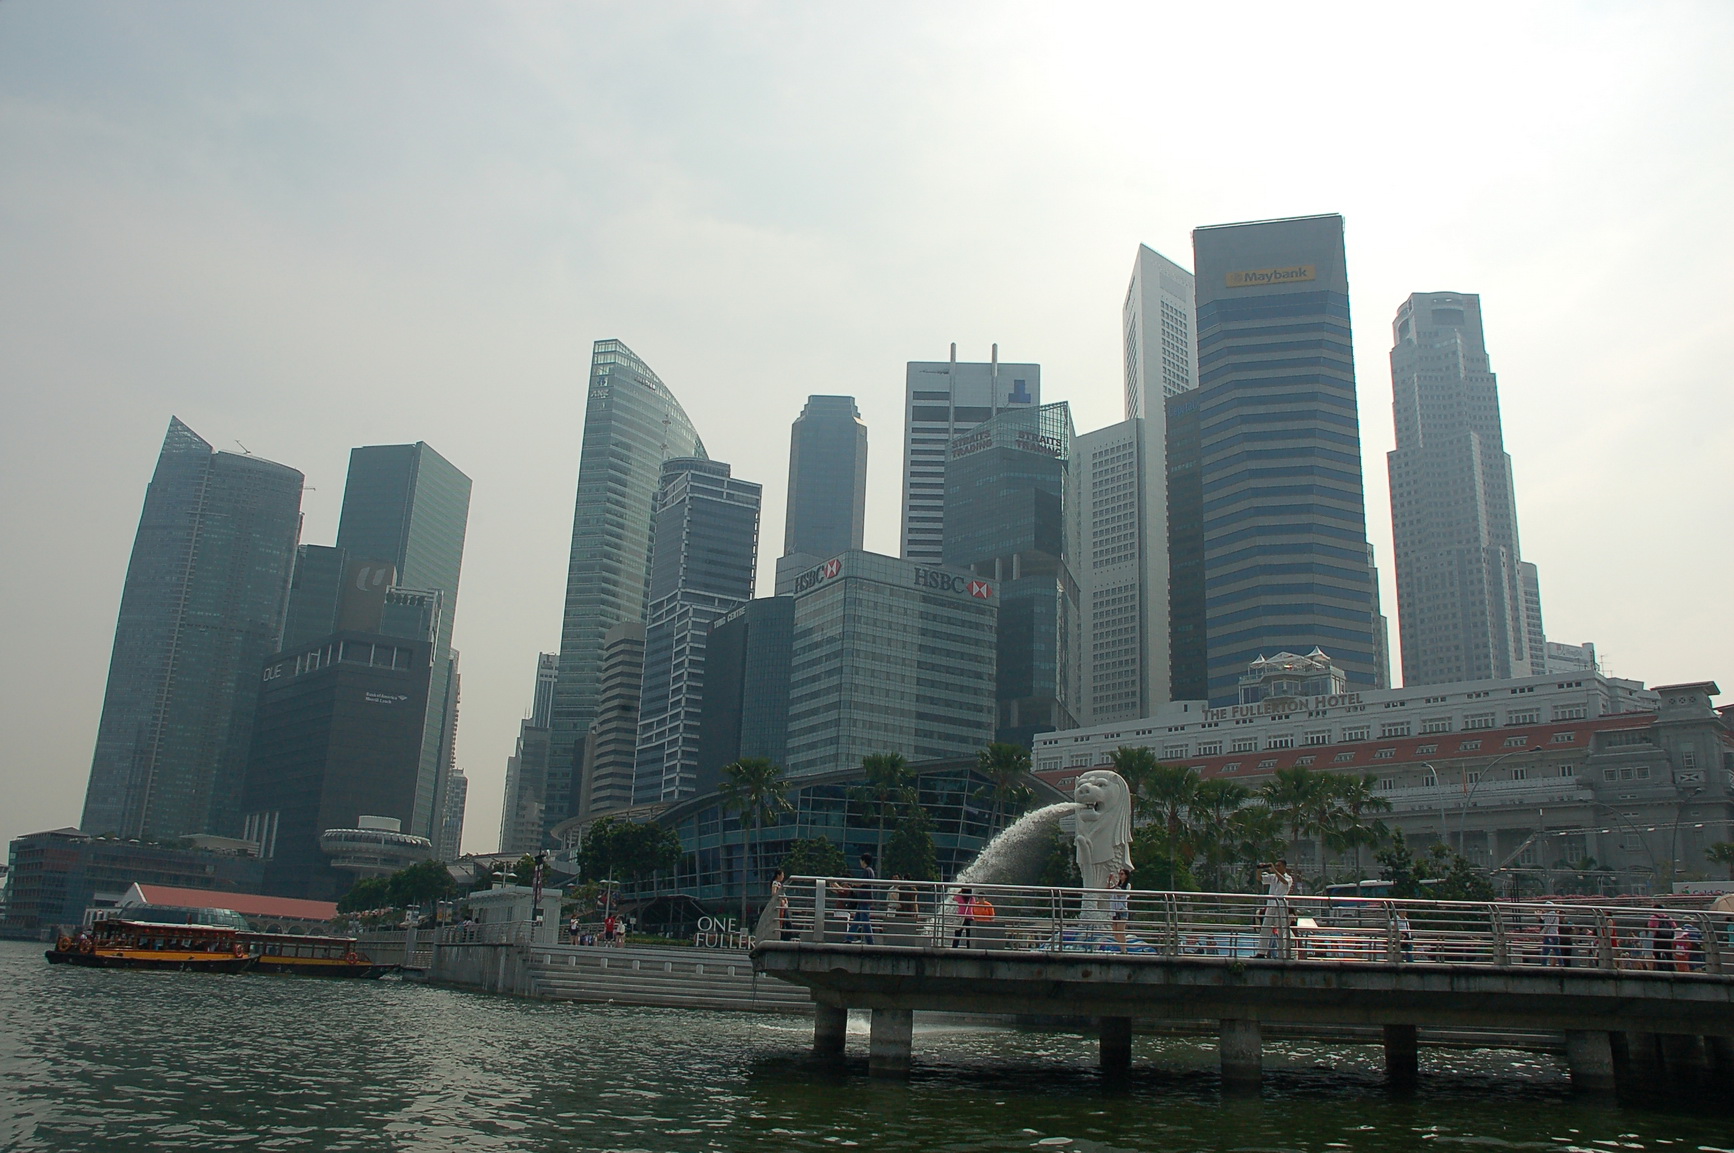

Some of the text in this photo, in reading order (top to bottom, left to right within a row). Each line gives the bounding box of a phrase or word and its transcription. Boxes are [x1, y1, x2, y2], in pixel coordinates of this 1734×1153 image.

[1244, 267, 1307, 282] Maybank
[951, 429, 991, 449] STRAITS
[1018, 430, 1062, 447] STRAITS
[952, 438, 993, 458] TRADING
[1015, 439, 1062, 457] TRADING
[795, 565, 824, 594] HSBC
[914, 567, 965, 593] HSBC
[263, 664, 283, 681] OUE
[1201, 692, 1363, 721] THE FULLERTON HOTEL
[697, 916, 737, 933] ONE
[696, 932, 757, 950] FULLER
